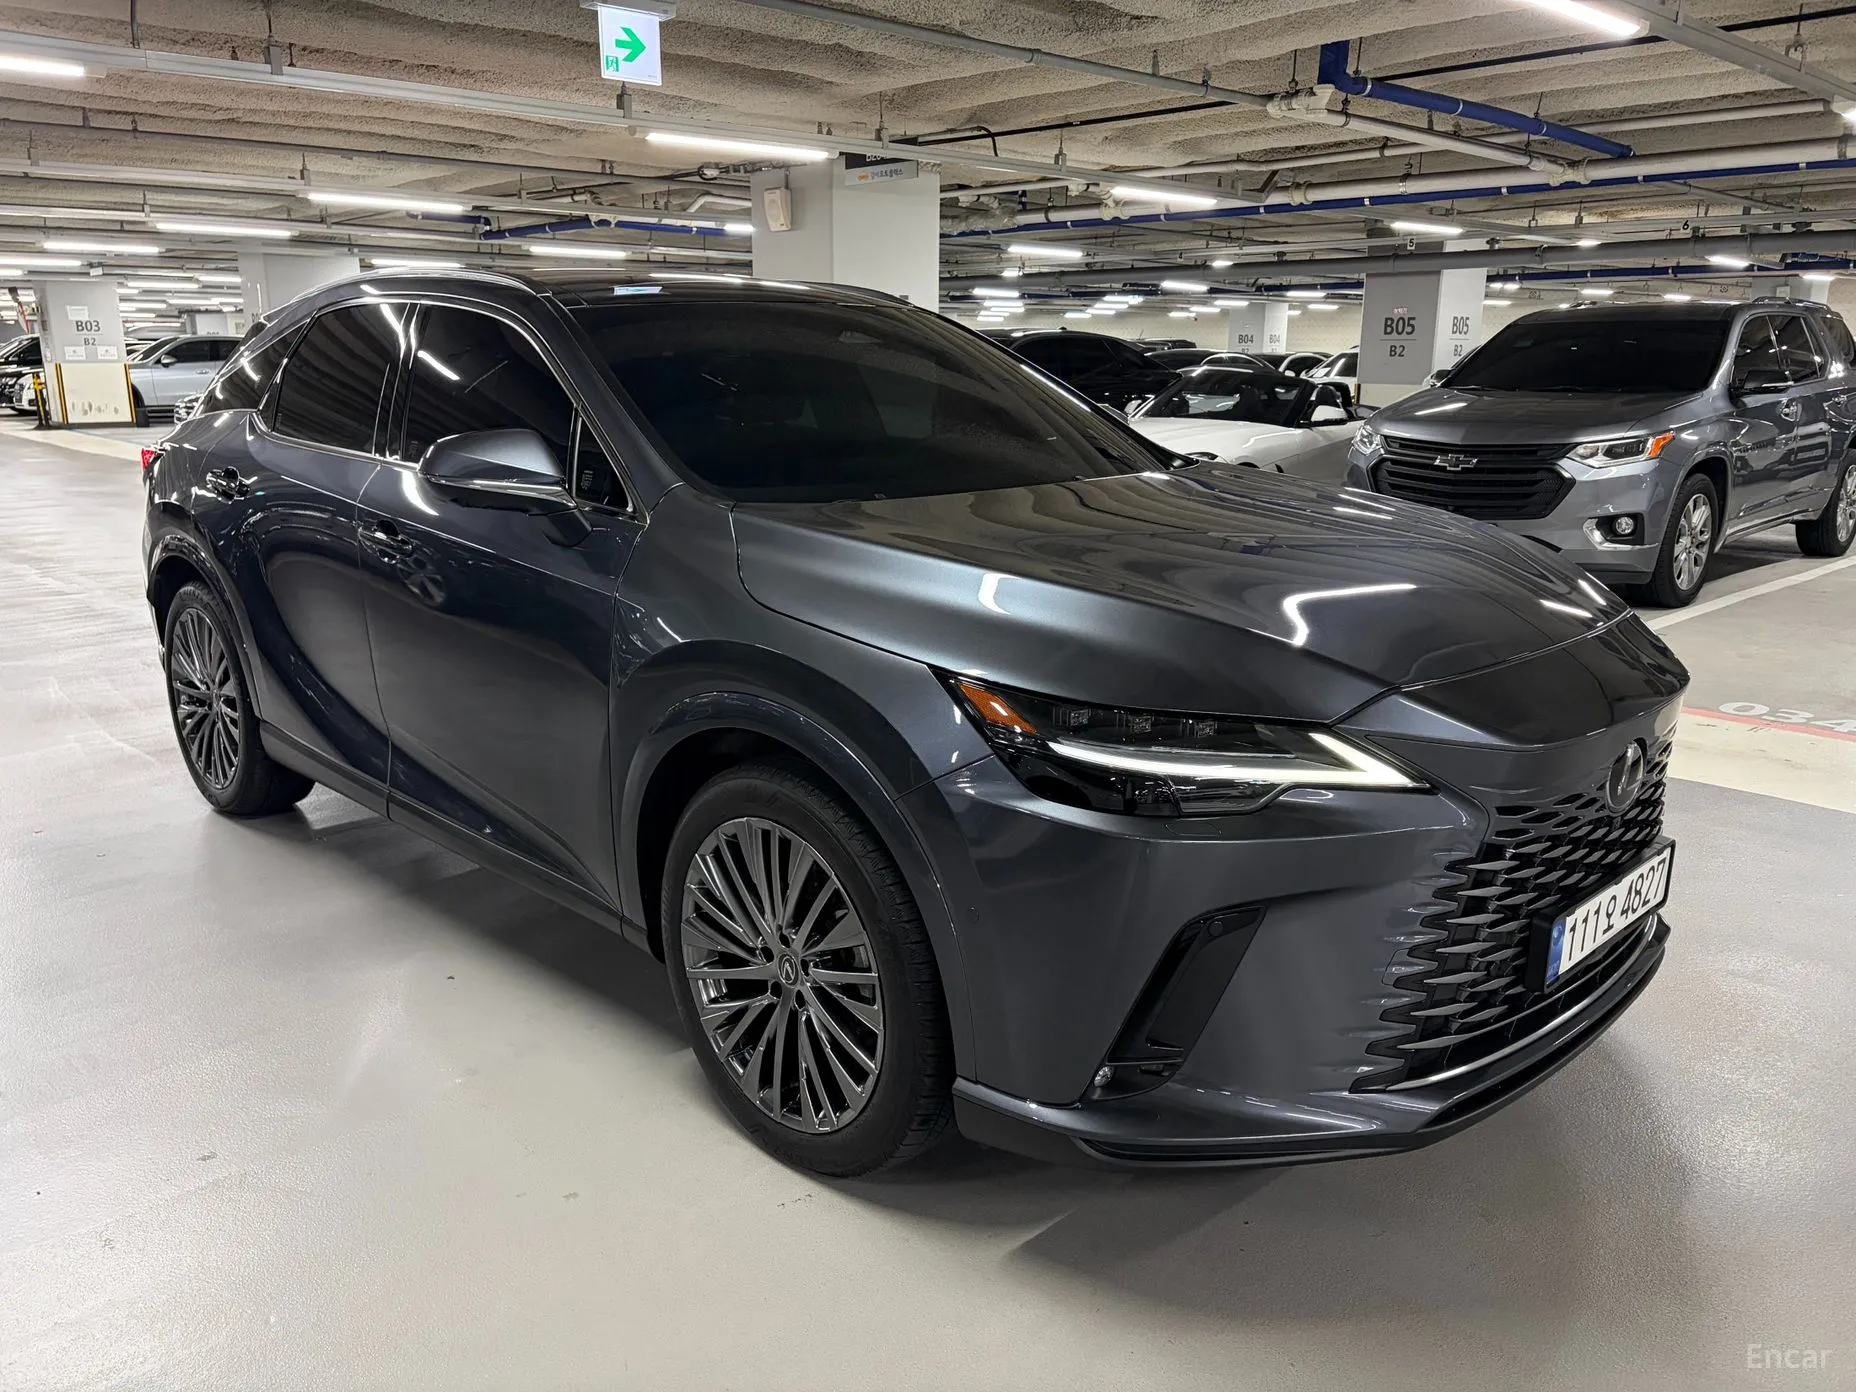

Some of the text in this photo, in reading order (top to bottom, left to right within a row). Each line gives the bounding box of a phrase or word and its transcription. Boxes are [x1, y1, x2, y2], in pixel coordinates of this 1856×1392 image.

[1682, 219, 1690, 231] 6
[1408, 238, 1415, 248] 5
[75, 320, 101, 333] B03
[1383, 317, 1417, 336] B05
[1451, 316, 1470, 336] B05
[83, 337, 97, 346] B2
[1238, 334, 1254, 344] B04
[1389, 344, 1406, 358] B2
[1453, 344, 1464, 357] B2
[1718, 701, 1856, 733] 034
[1568, 856, 1667, 962] 111오 4827
